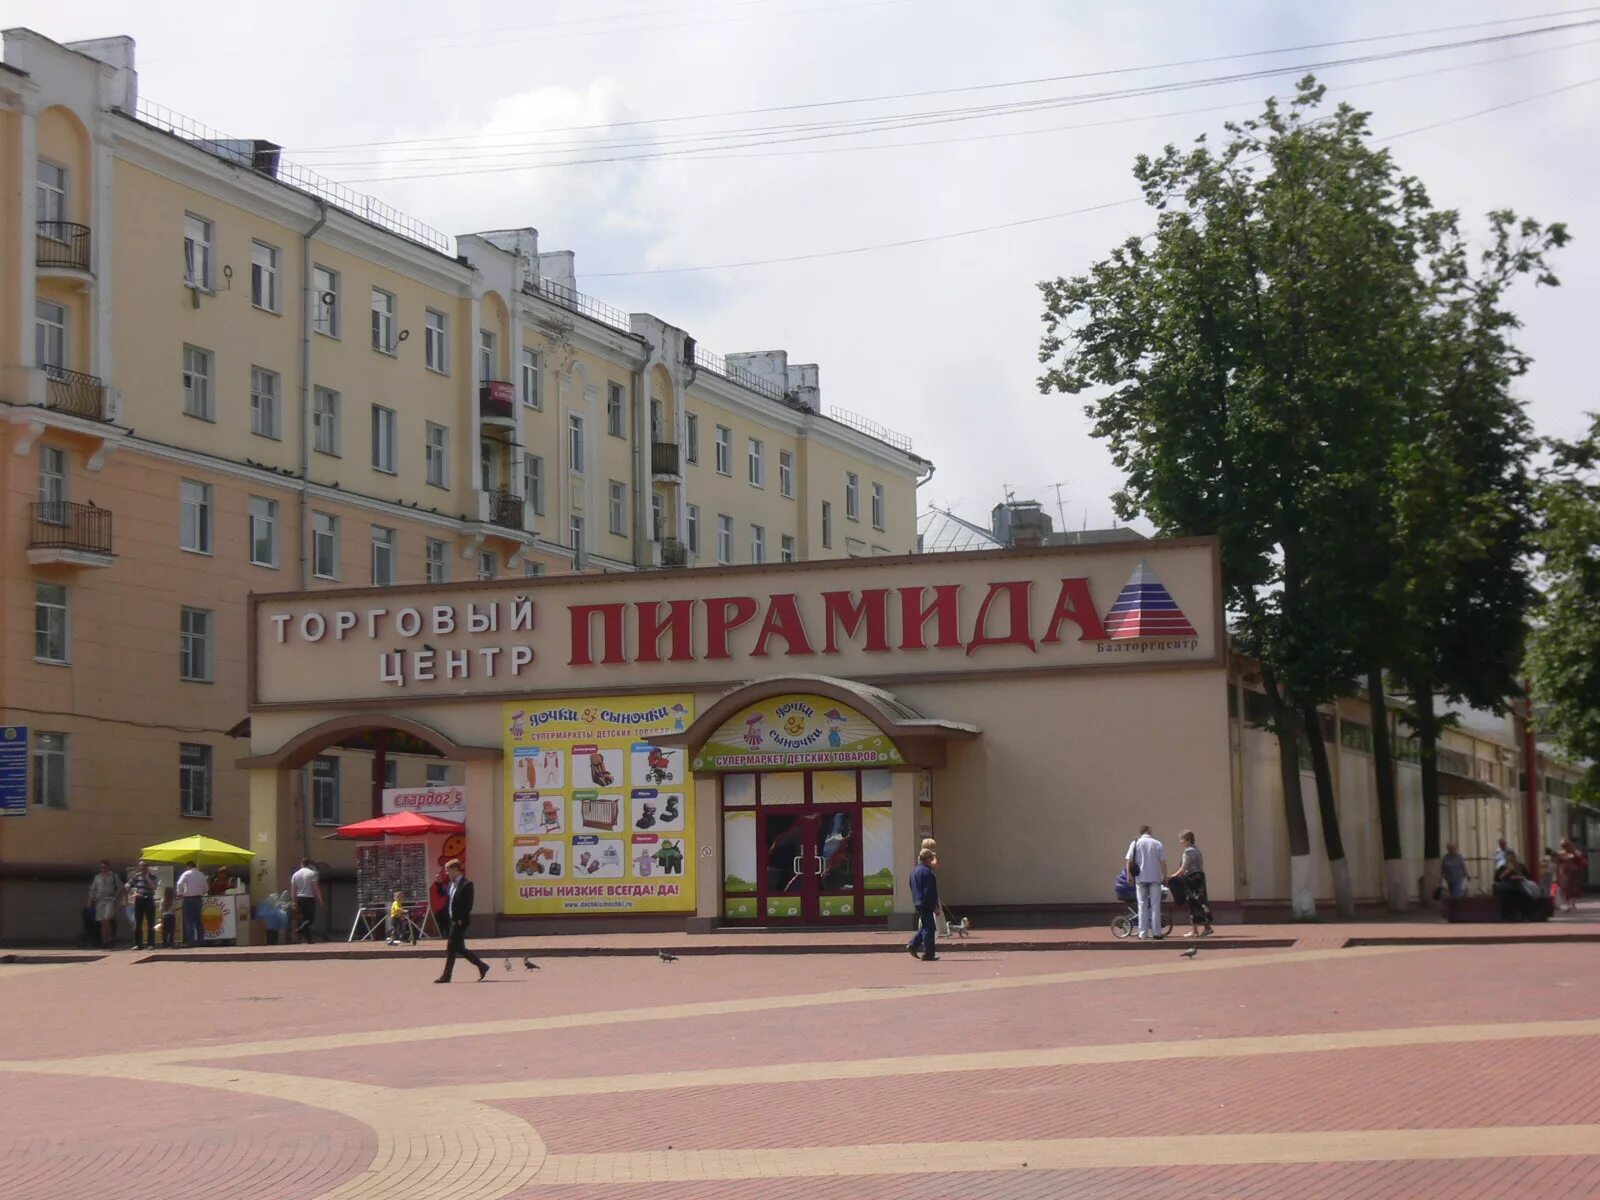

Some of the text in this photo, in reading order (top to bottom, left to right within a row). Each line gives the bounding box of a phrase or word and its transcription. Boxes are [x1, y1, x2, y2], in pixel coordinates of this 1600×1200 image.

[271, 596, 534, 643] ТОРГОВЫЙ
[567, 577, 1110, 666] ПИРАМИДА
[1097, 639, 1198, 653] Балторгцентр
[380, 645, 533, 686] ЦЕНТР
[531, 731, 593, 741] СУПЕРМАРКЕТЫ
[596, 729, 632, 740] ДЕТСКИХ
[716, 751, 877, 766] СУПЕРМАРКЕТ ДЕТСКИХ ТОВАРОВ
[519, 885, 679, 898] ЦЕНЫ НИЗКИЕ ВСЕГДА! ДА!
